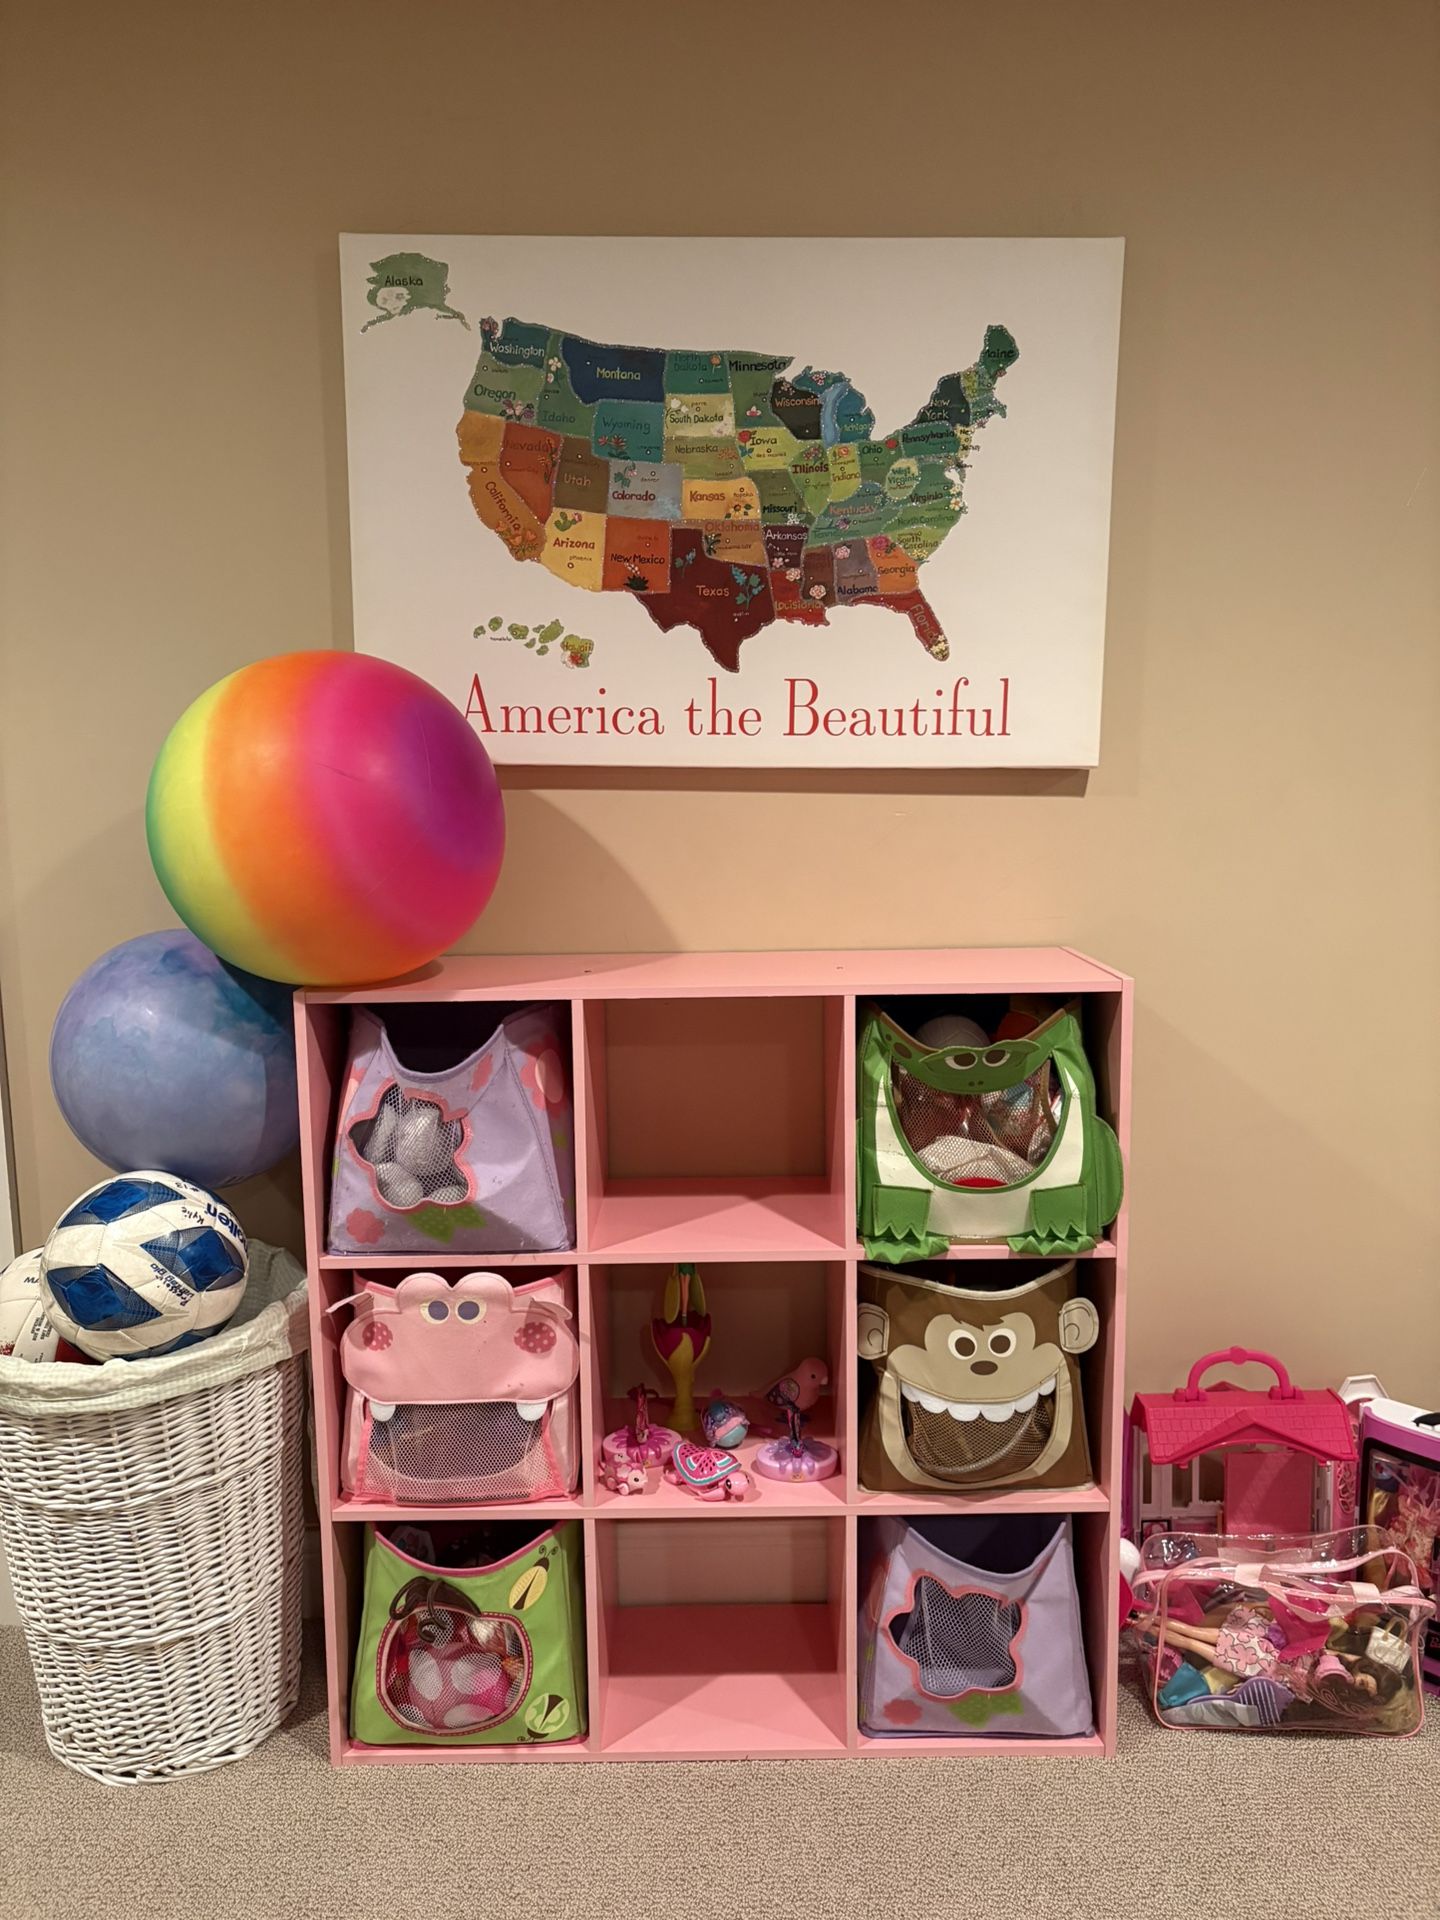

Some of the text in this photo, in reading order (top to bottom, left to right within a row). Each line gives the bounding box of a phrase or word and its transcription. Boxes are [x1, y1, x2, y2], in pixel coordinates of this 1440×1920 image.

[384, 275, 424, 287] Alaska
[489, 342, 545, 358] Washington
[728, 357, 787, 372] Minnesota
[596, 367, 641, 381] Montana
[473, 384, 517, 402] Oregon
[775, 396, 822, 407] Wisconsin
[541, 410, 576, 424] Idaho
[669, 413, 724, 424] South Dakota
[602, 416, 651, 435] Wyoming
[503, 439, 550, 453] Nevada
[750, 436, 778, 446] Iowa
[674, 443, 719, 454] Nebraska
[861, 445, 883, 455] Ohio
[792, 462, 830, 475] Illinois
[563, 474, 591, 488] Utah
[832, 472, 860, 483] Indiana
[612, 490, 656, 502] Colorado
[689, 491, 726, 503] Kansas
[909, 491, 944, 504] Virginia
[485, 481, 522, 532] California
[762, 501, 798, 513] Missouri
[829, 504, 877, 516] Kentucky
[704, 521, 760, 533] Oklahoma
[765, 529, 808, 541] Arkansas
[552, 538, 596, 550] Arizona
[610, 553, 666, 565] New Mexico
[877, 563, 916, 577] Georgia
[696, 584, 730, 597] Texas
[837, 585, 878, 595] Alabama
[464, 672, 1012, 737] America the Beautiful
[181, 1205, 205, 1225] Kylie
[206, 1202, 248, 1255] olten
